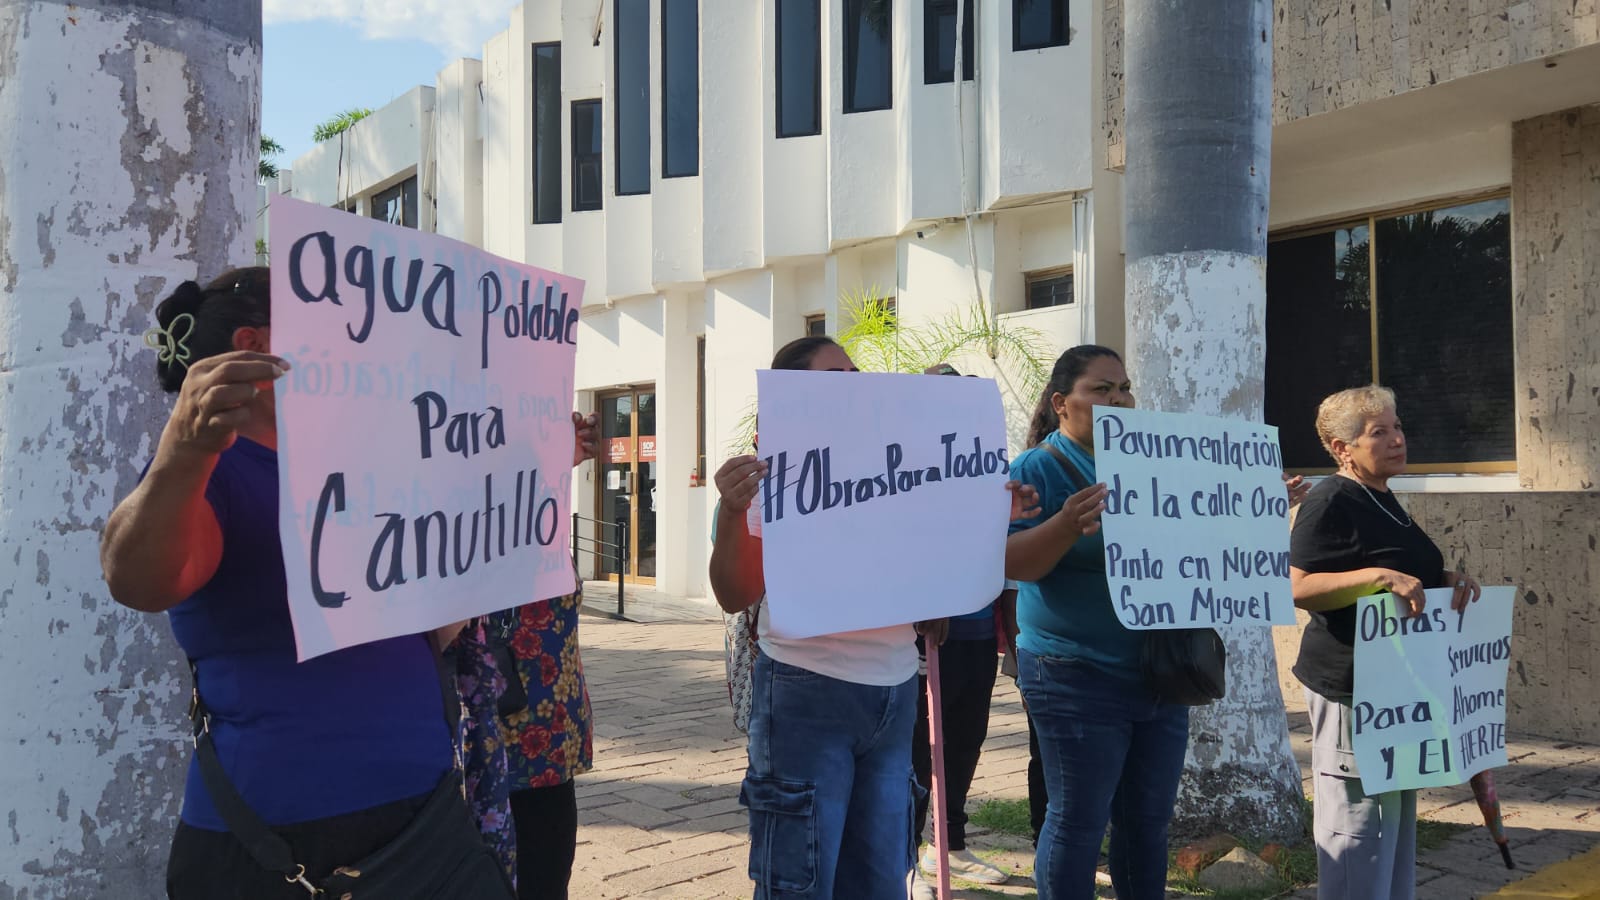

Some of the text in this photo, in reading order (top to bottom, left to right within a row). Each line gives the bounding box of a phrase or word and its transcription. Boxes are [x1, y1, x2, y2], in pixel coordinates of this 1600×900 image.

[478, 270, 578, 369] Potable
[411, 390, 506, 459] Para
[760, 432, 1009, 523] #ObrasParaTodos
[1105, 473, 1138, 515] de
[1151, 477, 1182, 519] la
[1191, 482, 1243, 518] calle
[310, 469, 558, 609] Canutillo
[1178, 555, 1211, 581] en
[1120, 585, 1271, 626] San Miguel
[1360, 598, 1446, 642] Obras
[1354, 685, 1504, 735] Para Ahome
[1418, 738, 1450, 775] El
[1460, 723, 1505, 769] FUERTE
